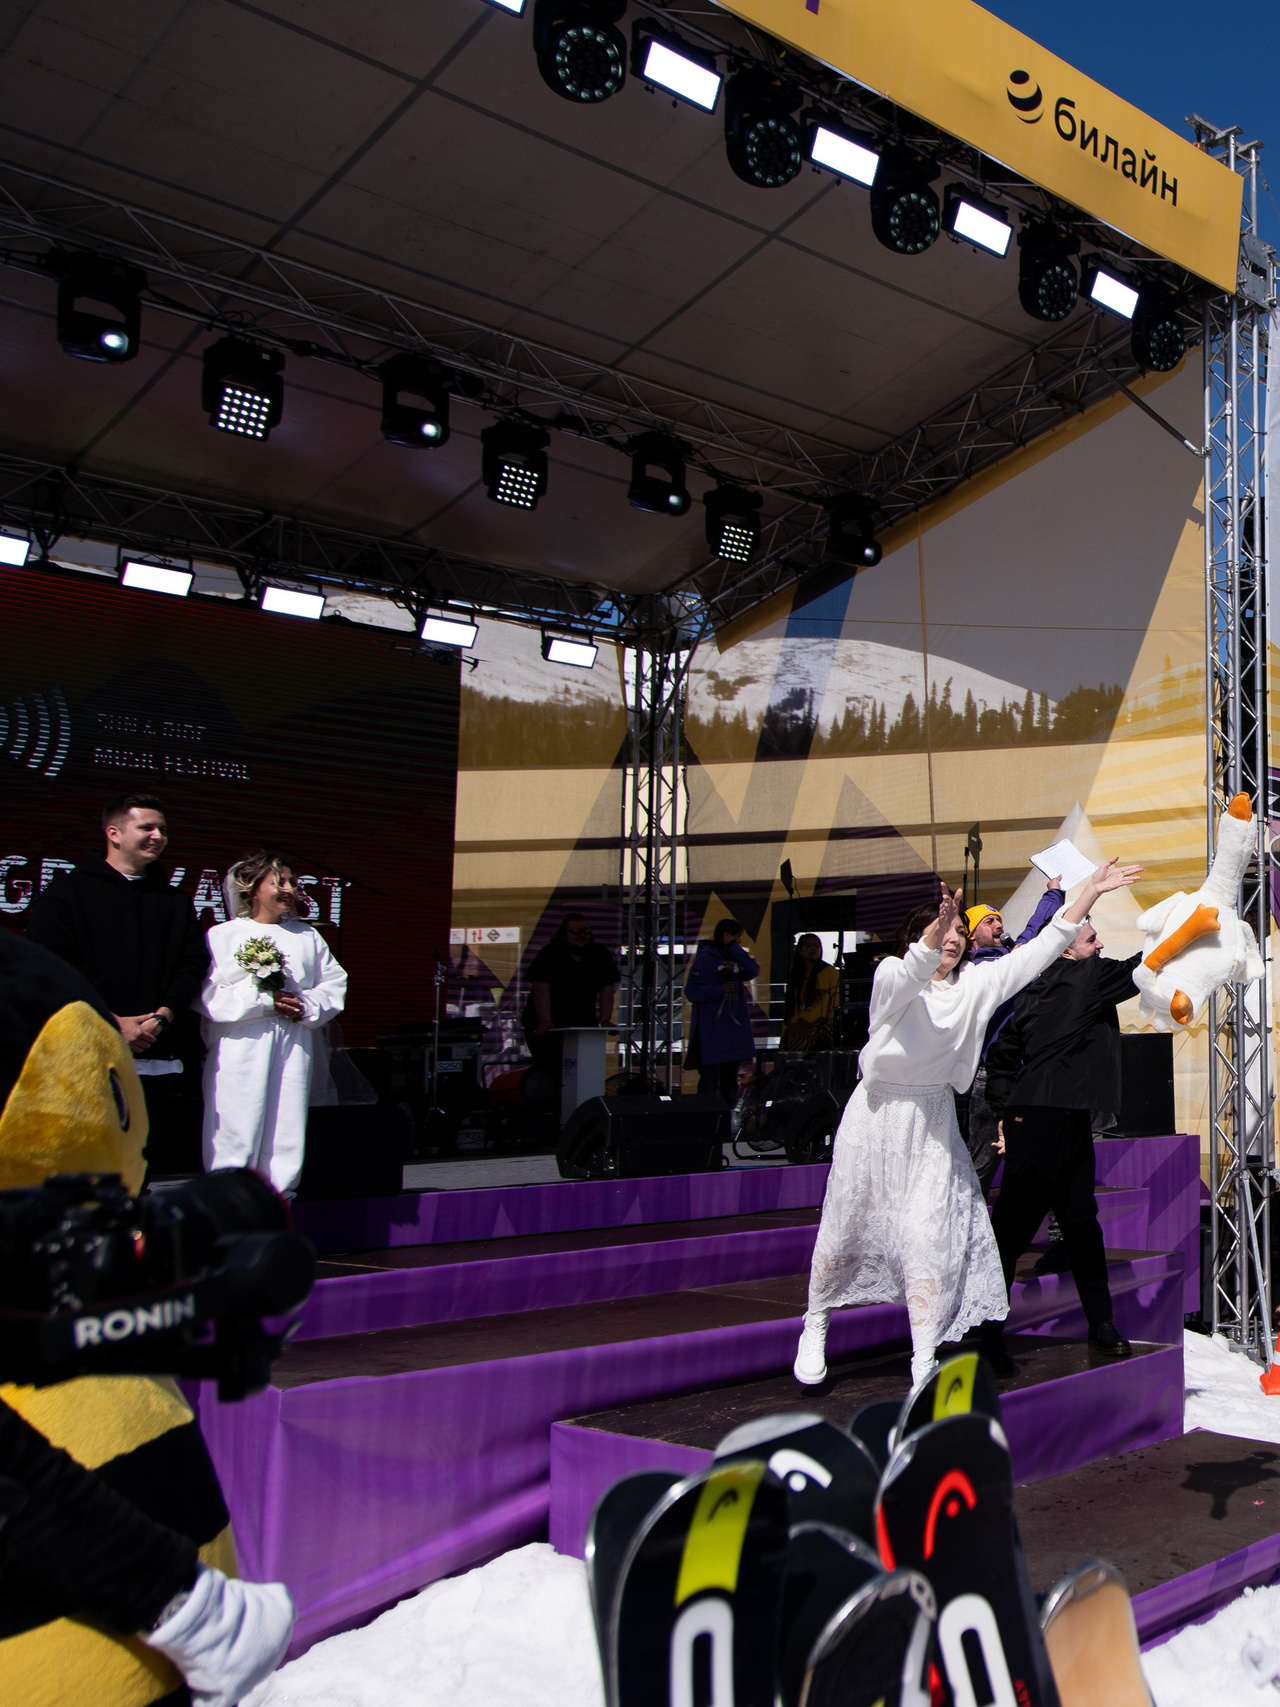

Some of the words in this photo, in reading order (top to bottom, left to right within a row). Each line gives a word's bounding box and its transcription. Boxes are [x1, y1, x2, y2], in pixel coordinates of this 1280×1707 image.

[1054, 97, 1178, 208] билайн
[94, 748, 159, 769] MUSIC
[163, 755, 252, 780] FESTIVAL
[438, 1062, 461, 1071] S250
[75, 1294, 195, 1349] RONIN
